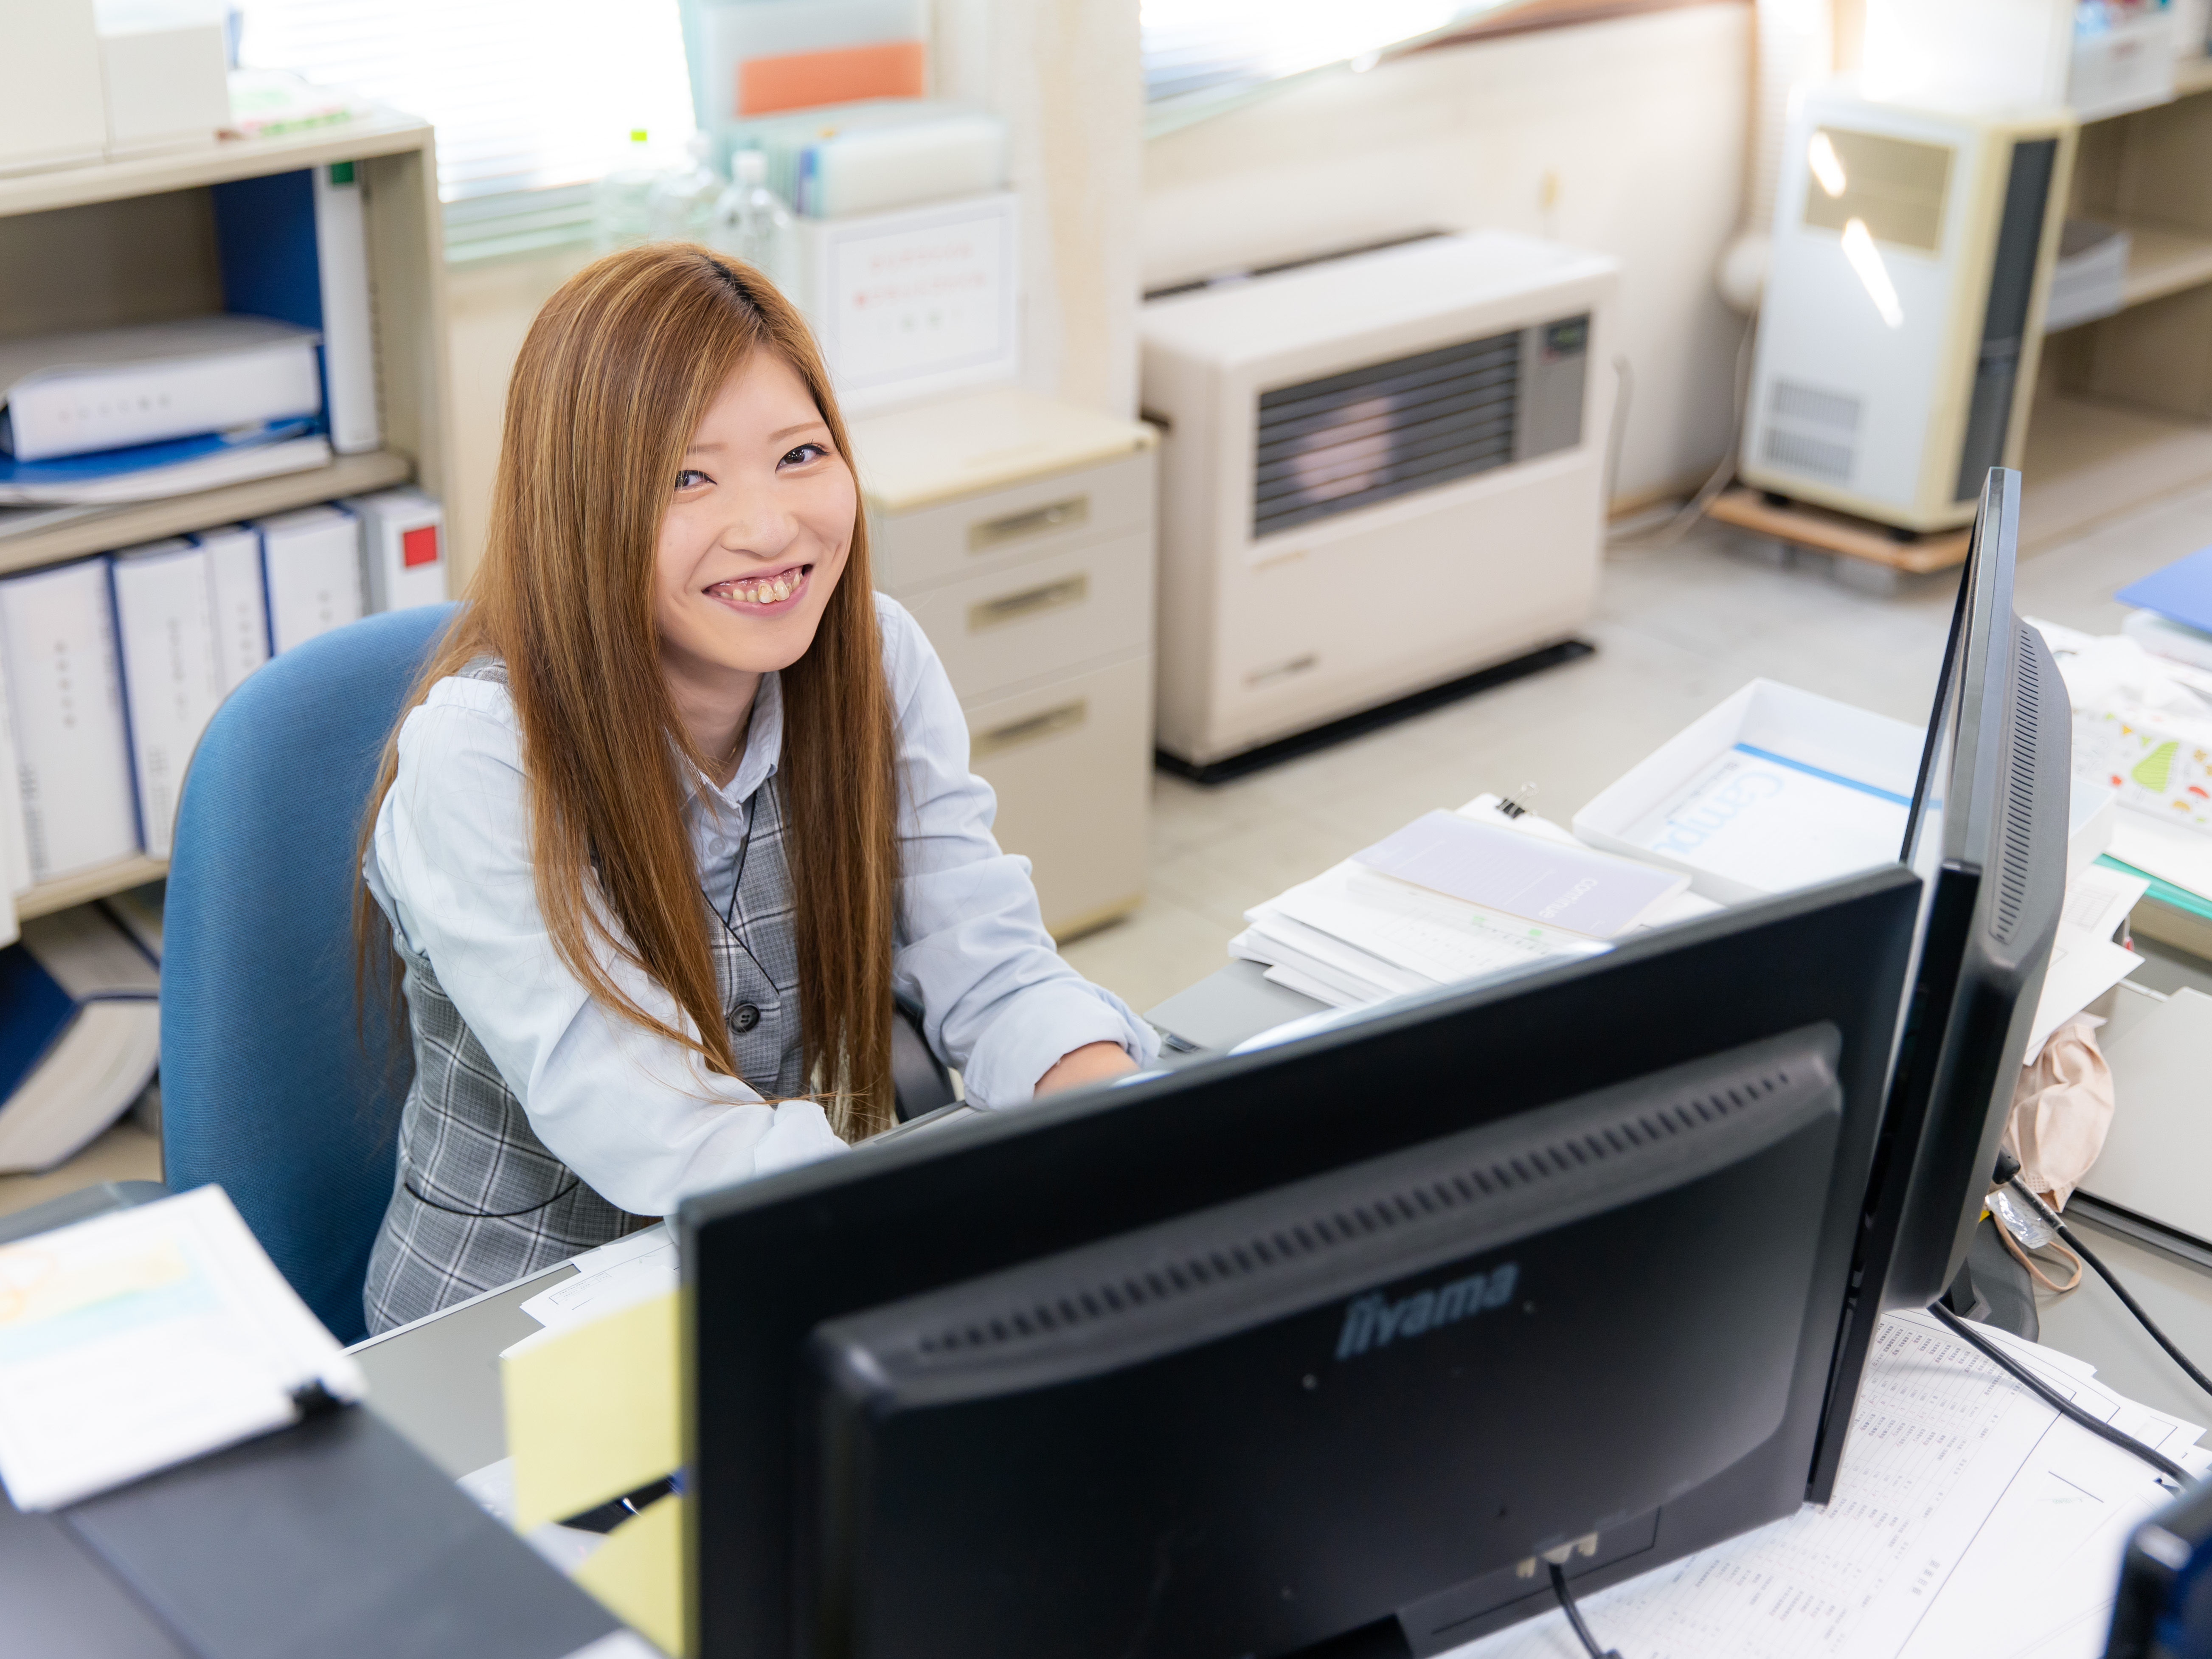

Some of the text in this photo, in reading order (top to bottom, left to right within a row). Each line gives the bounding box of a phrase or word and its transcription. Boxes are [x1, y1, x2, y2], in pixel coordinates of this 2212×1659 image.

[1538, 877, 1599, 919] continue
[1912, 1560, 1940, 1595] 図面目録
